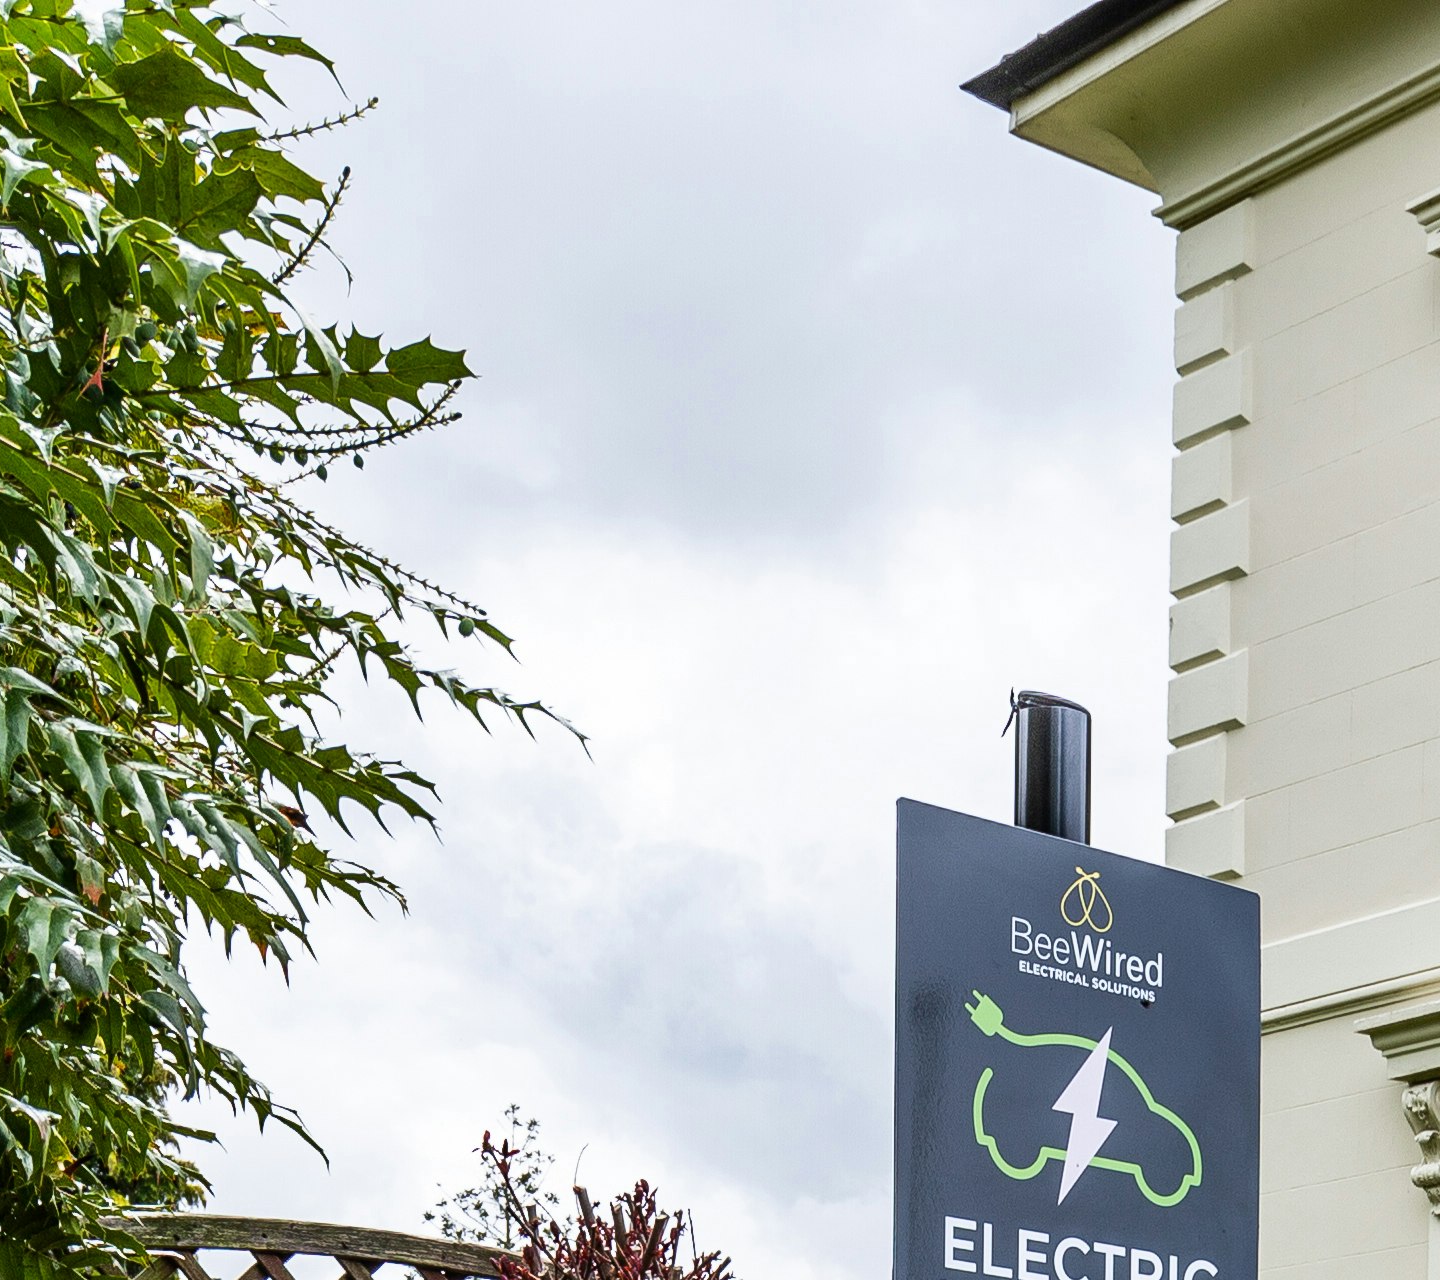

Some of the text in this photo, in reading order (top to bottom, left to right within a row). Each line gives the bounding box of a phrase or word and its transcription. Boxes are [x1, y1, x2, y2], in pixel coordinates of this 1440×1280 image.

[1011, 916, 1163, 988] BeeWired
[1018, 960, 1156, 1003] ELECTRICAL SOLUTIONS
